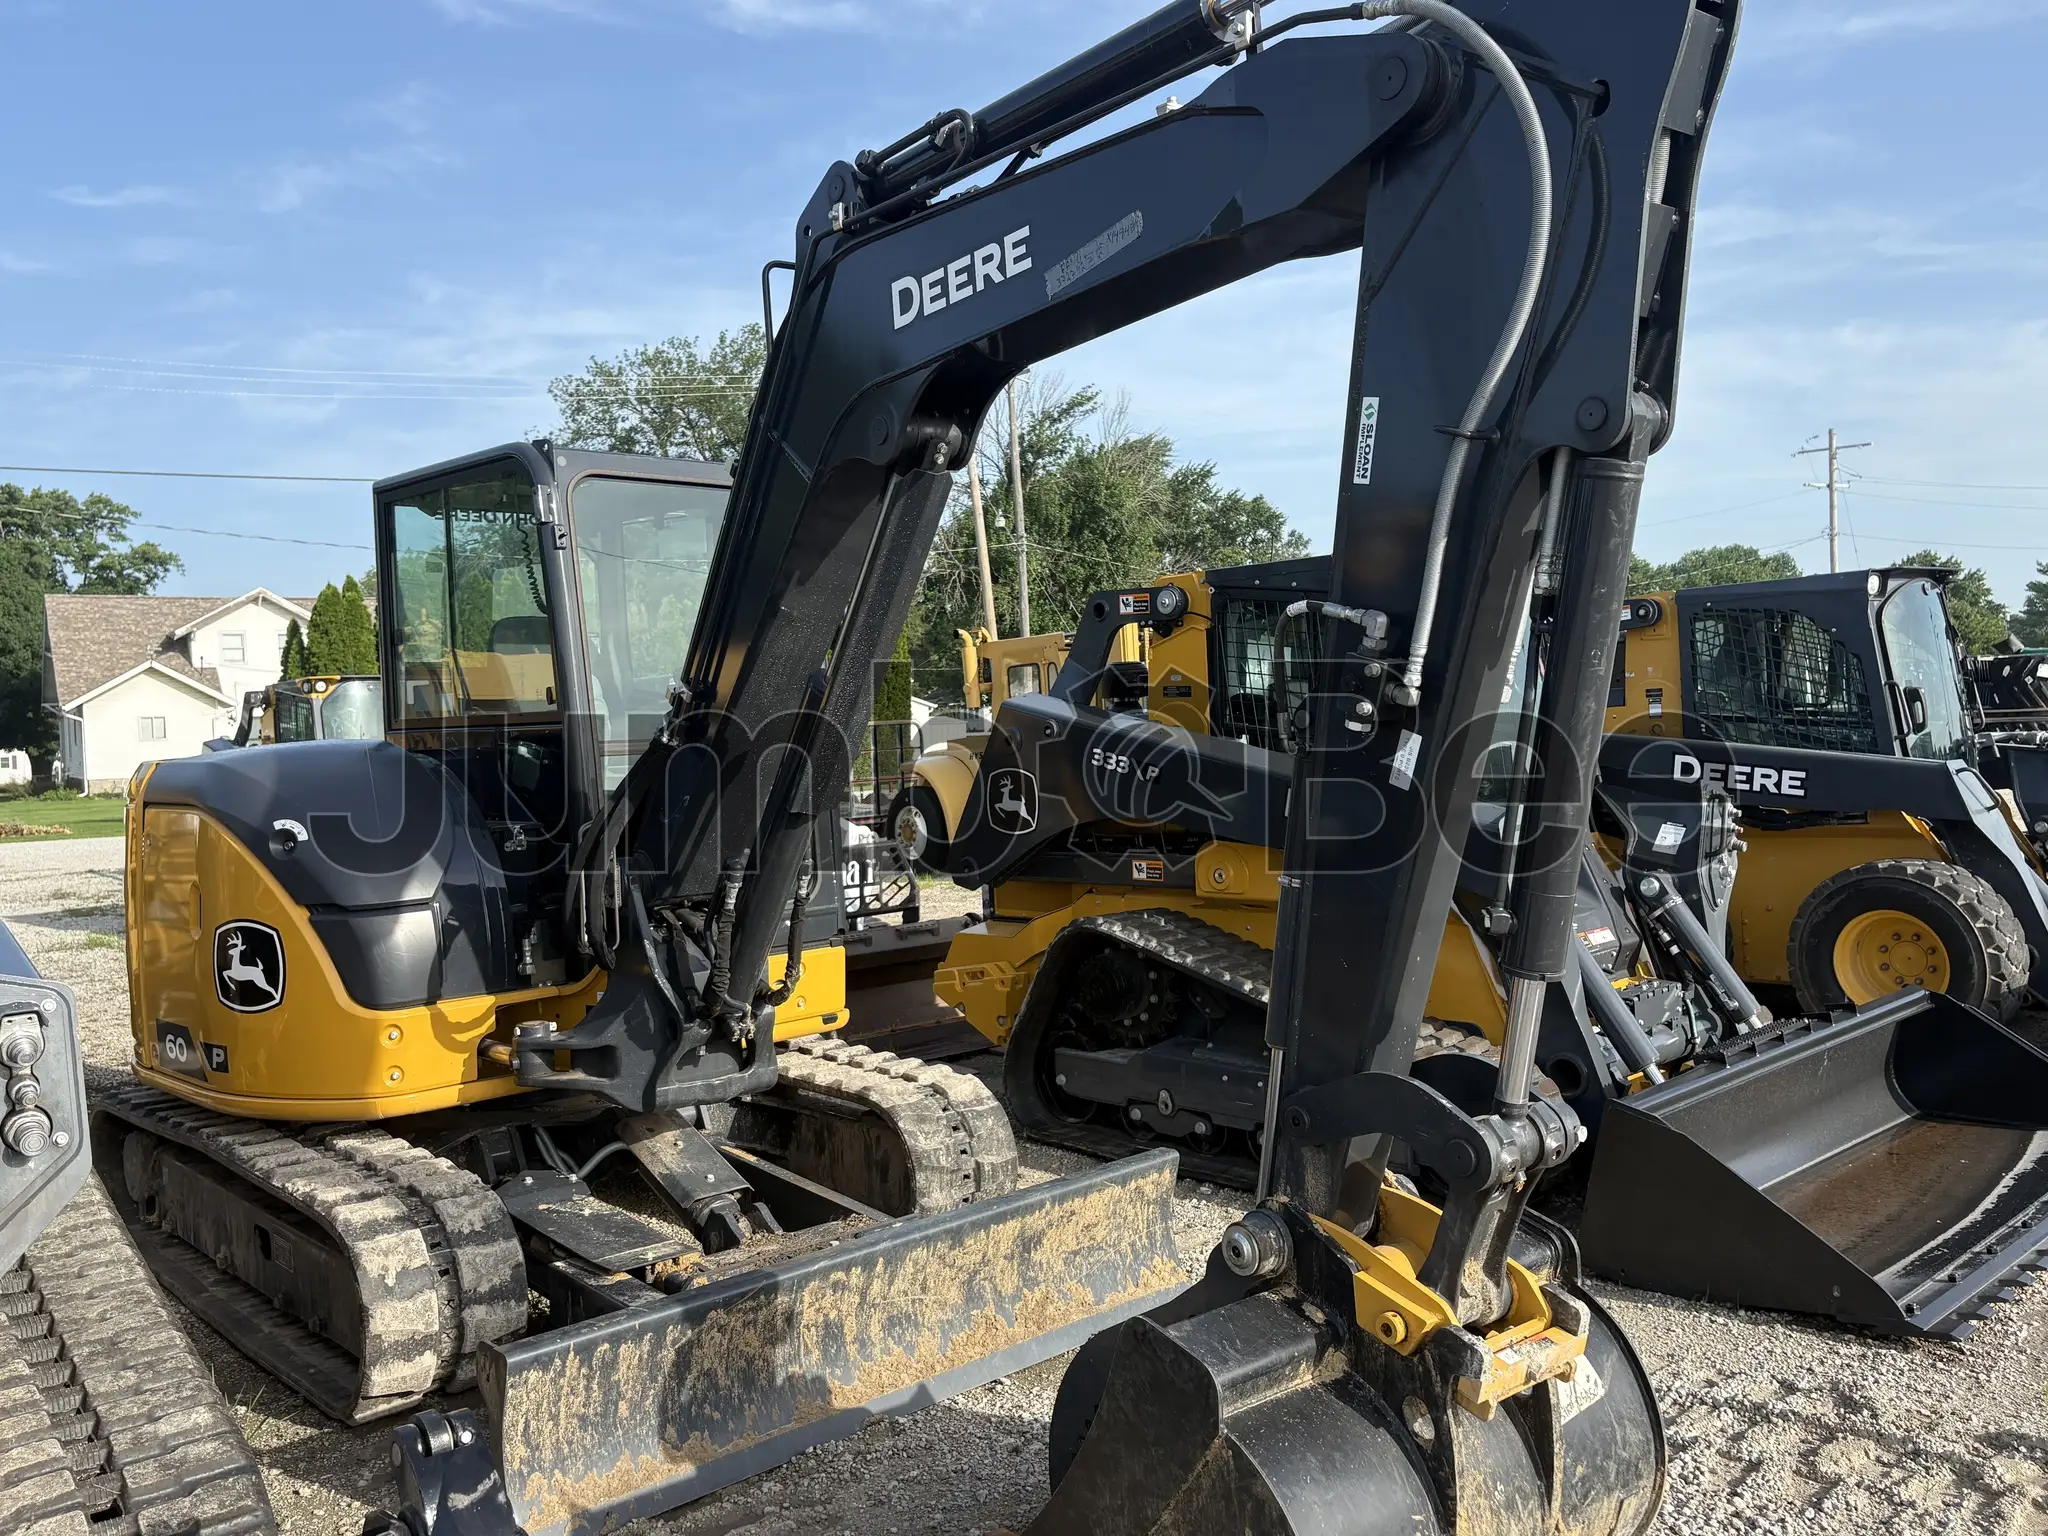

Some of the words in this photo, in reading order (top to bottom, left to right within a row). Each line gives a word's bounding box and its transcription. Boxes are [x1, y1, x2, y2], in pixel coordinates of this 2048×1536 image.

[891, 225, 1032, 330] DEERE
[1356, 423, 1366, 479] IMPLEMENT
[1361, 424, 1374, 479] SLOAN
[1091, 748, 1130, 774] 333
[1145, 766, 1159, 781] P
[1673, 754, 1807, 797] DEERE
[165, 1033, 187, 1062] 60
[212, 1048, 225, 1068] P
